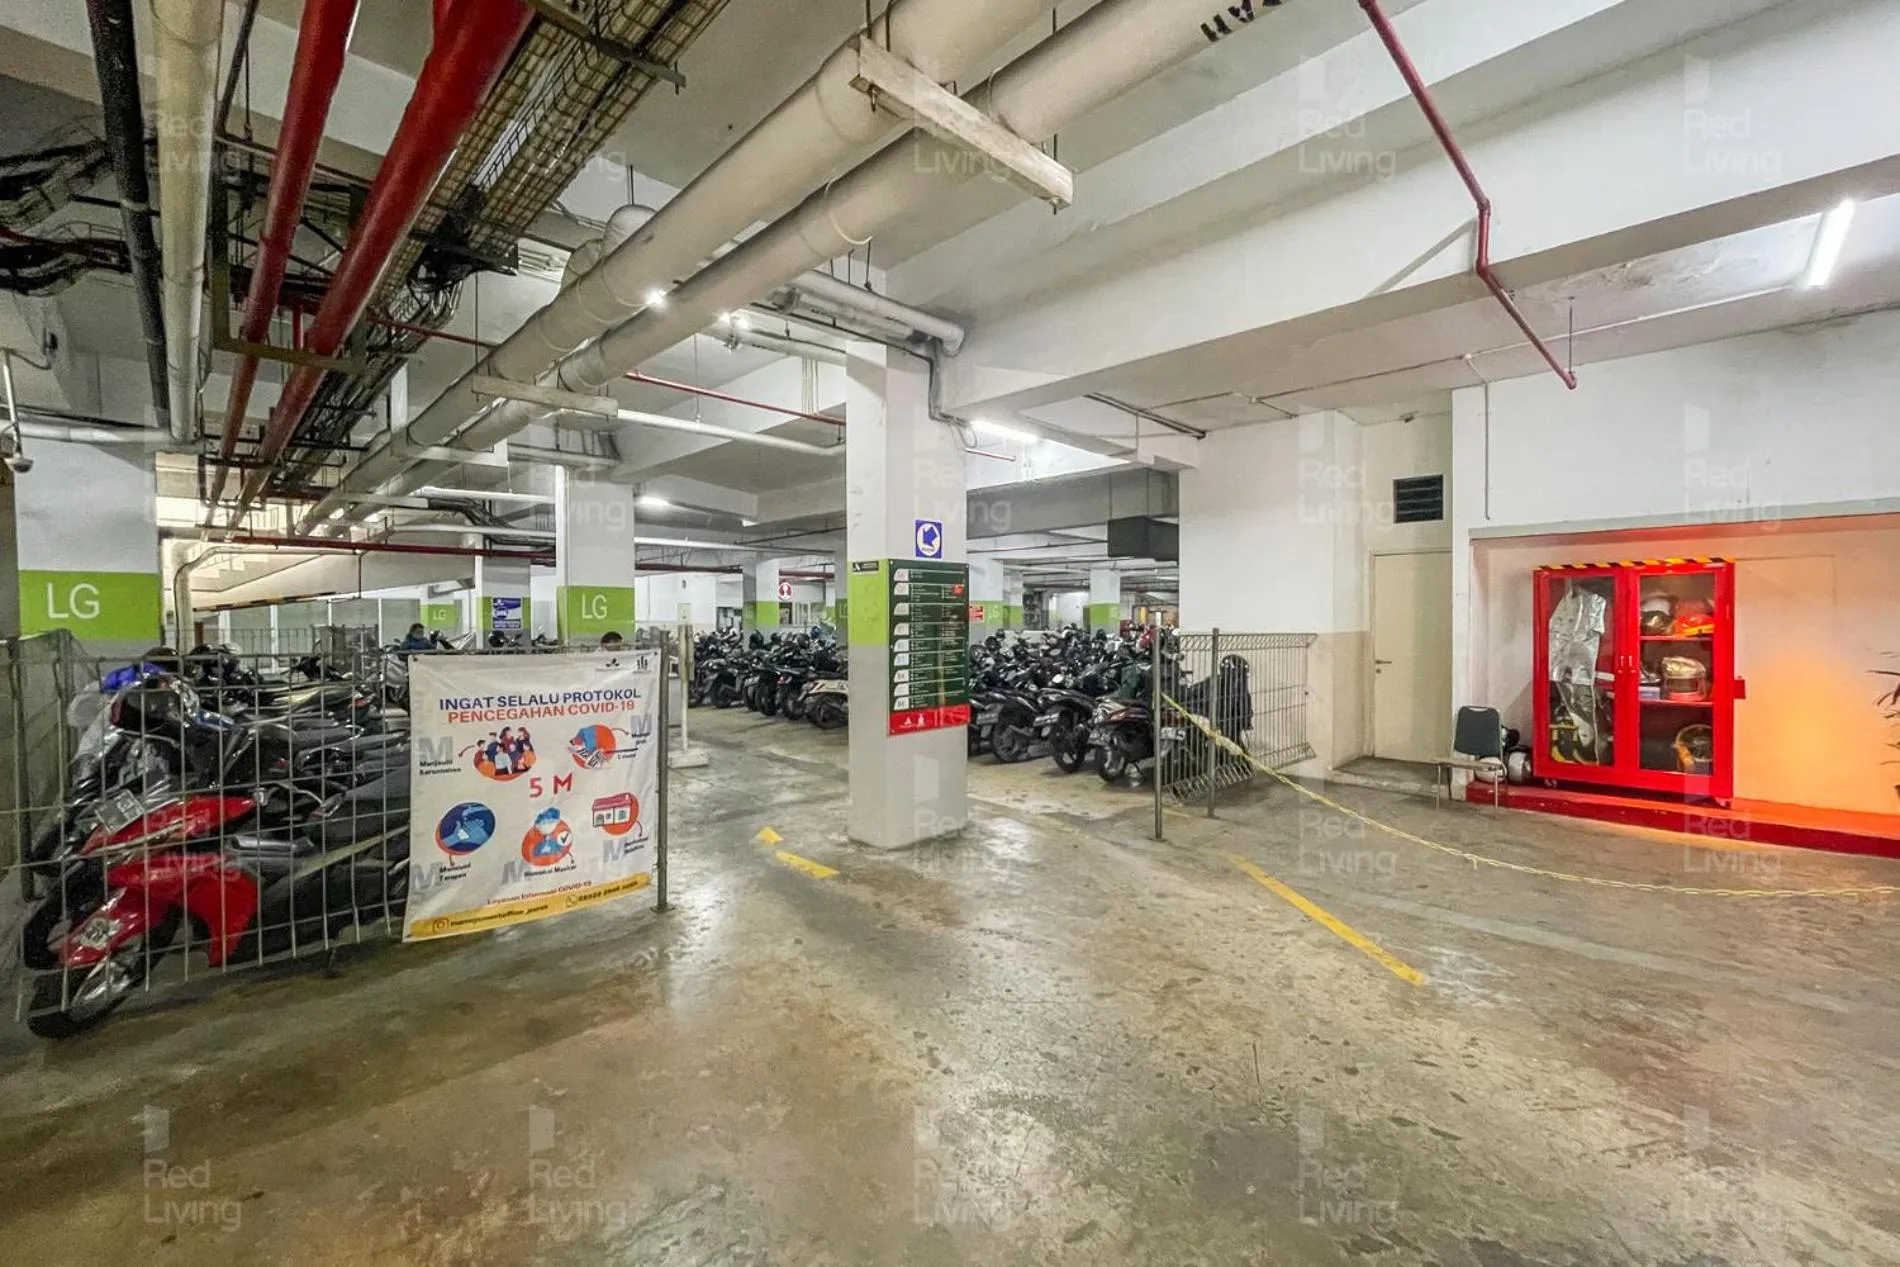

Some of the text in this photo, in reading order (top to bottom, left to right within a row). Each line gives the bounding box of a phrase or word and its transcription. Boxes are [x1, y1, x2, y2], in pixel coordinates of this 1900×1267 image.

[47, 582, 99, 618] LG
[582, 594, 607, 619] LG
[433, 609, 447, 620] LG
[440, 688, 641, 710] INGAT SELALU PROTOKOL
[448, 700, 634, 724] PENCEGAHAN COVID-19
[419, 736, 453, 762] M
[529, 772, 572, 797] 5 M
[604, 839, 626, 863] M
[409, 863, 442, 889] M
